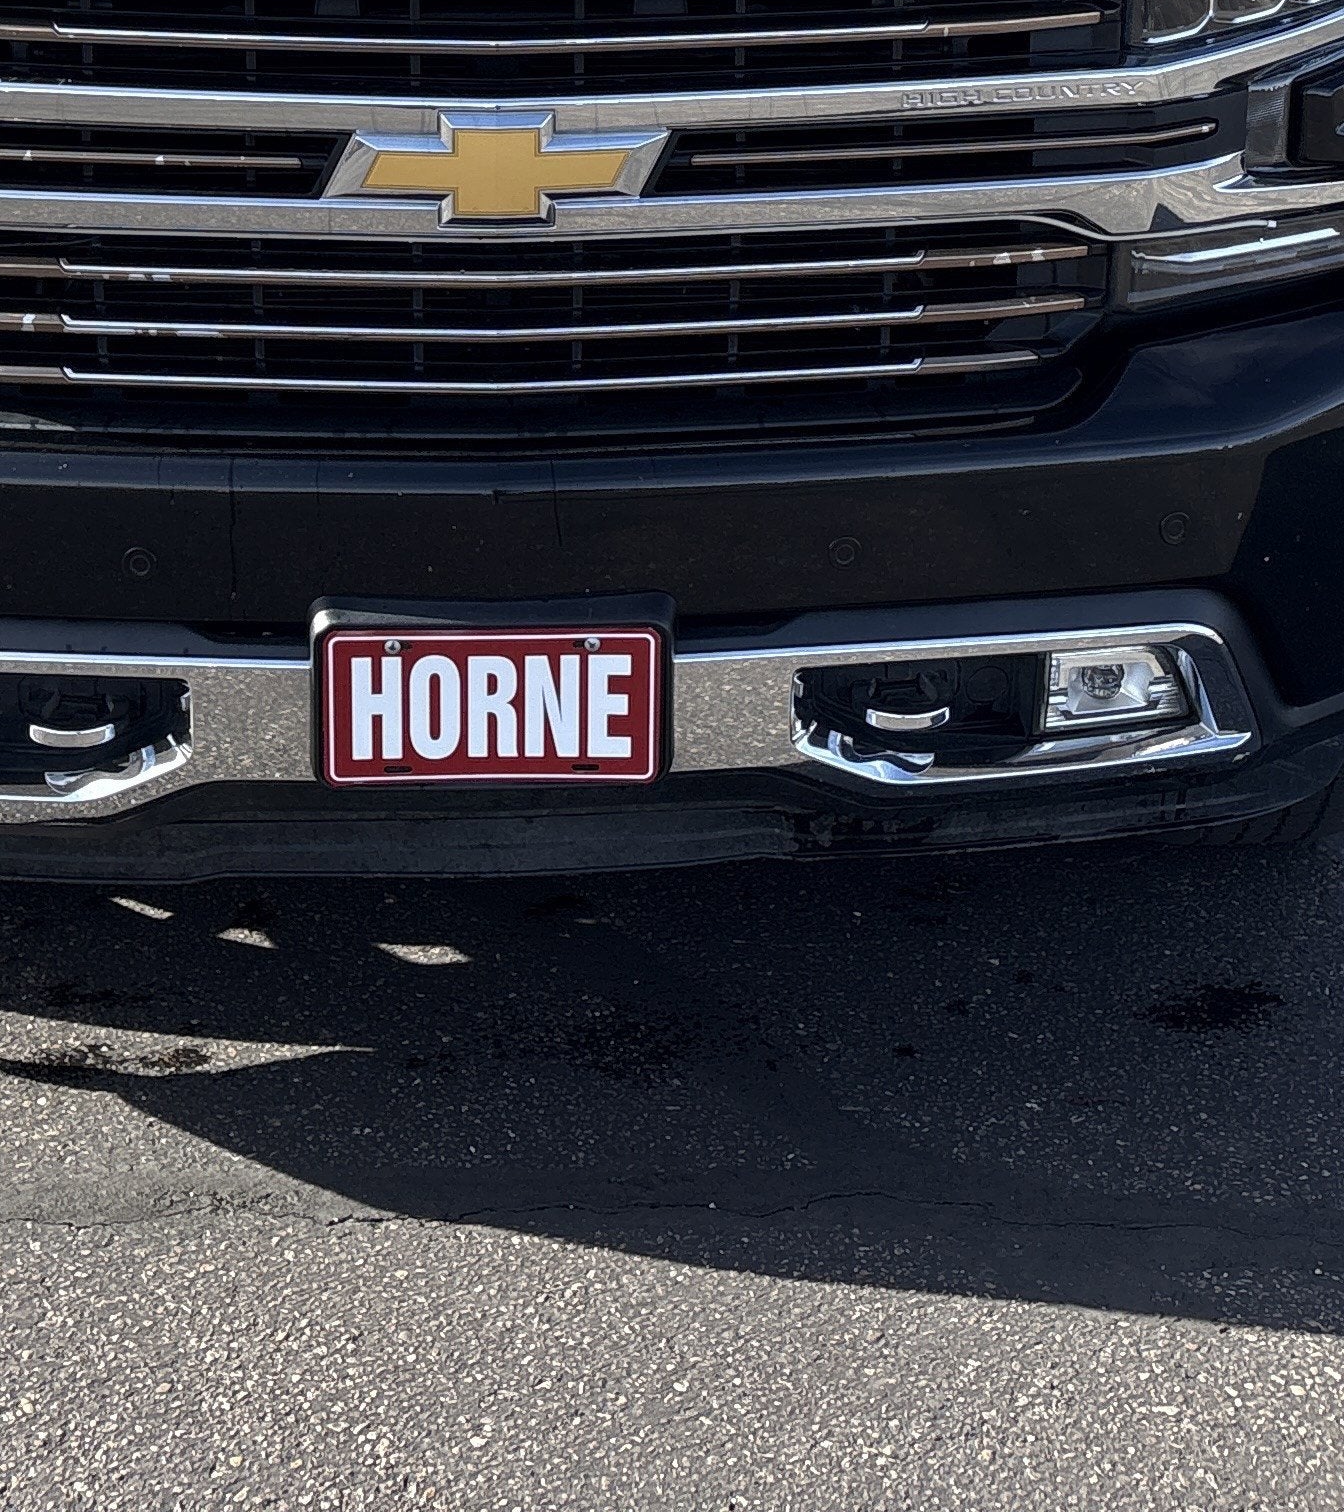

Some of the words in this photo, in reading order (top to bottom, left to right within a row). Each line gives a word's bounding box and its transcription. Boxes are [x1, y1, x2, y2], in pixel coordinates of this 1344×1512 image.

[901, 89, 983, 108] HIGH
[992, 81, 1144, 104] COUNTRY
[350, 653, 633, 760] HORNE
